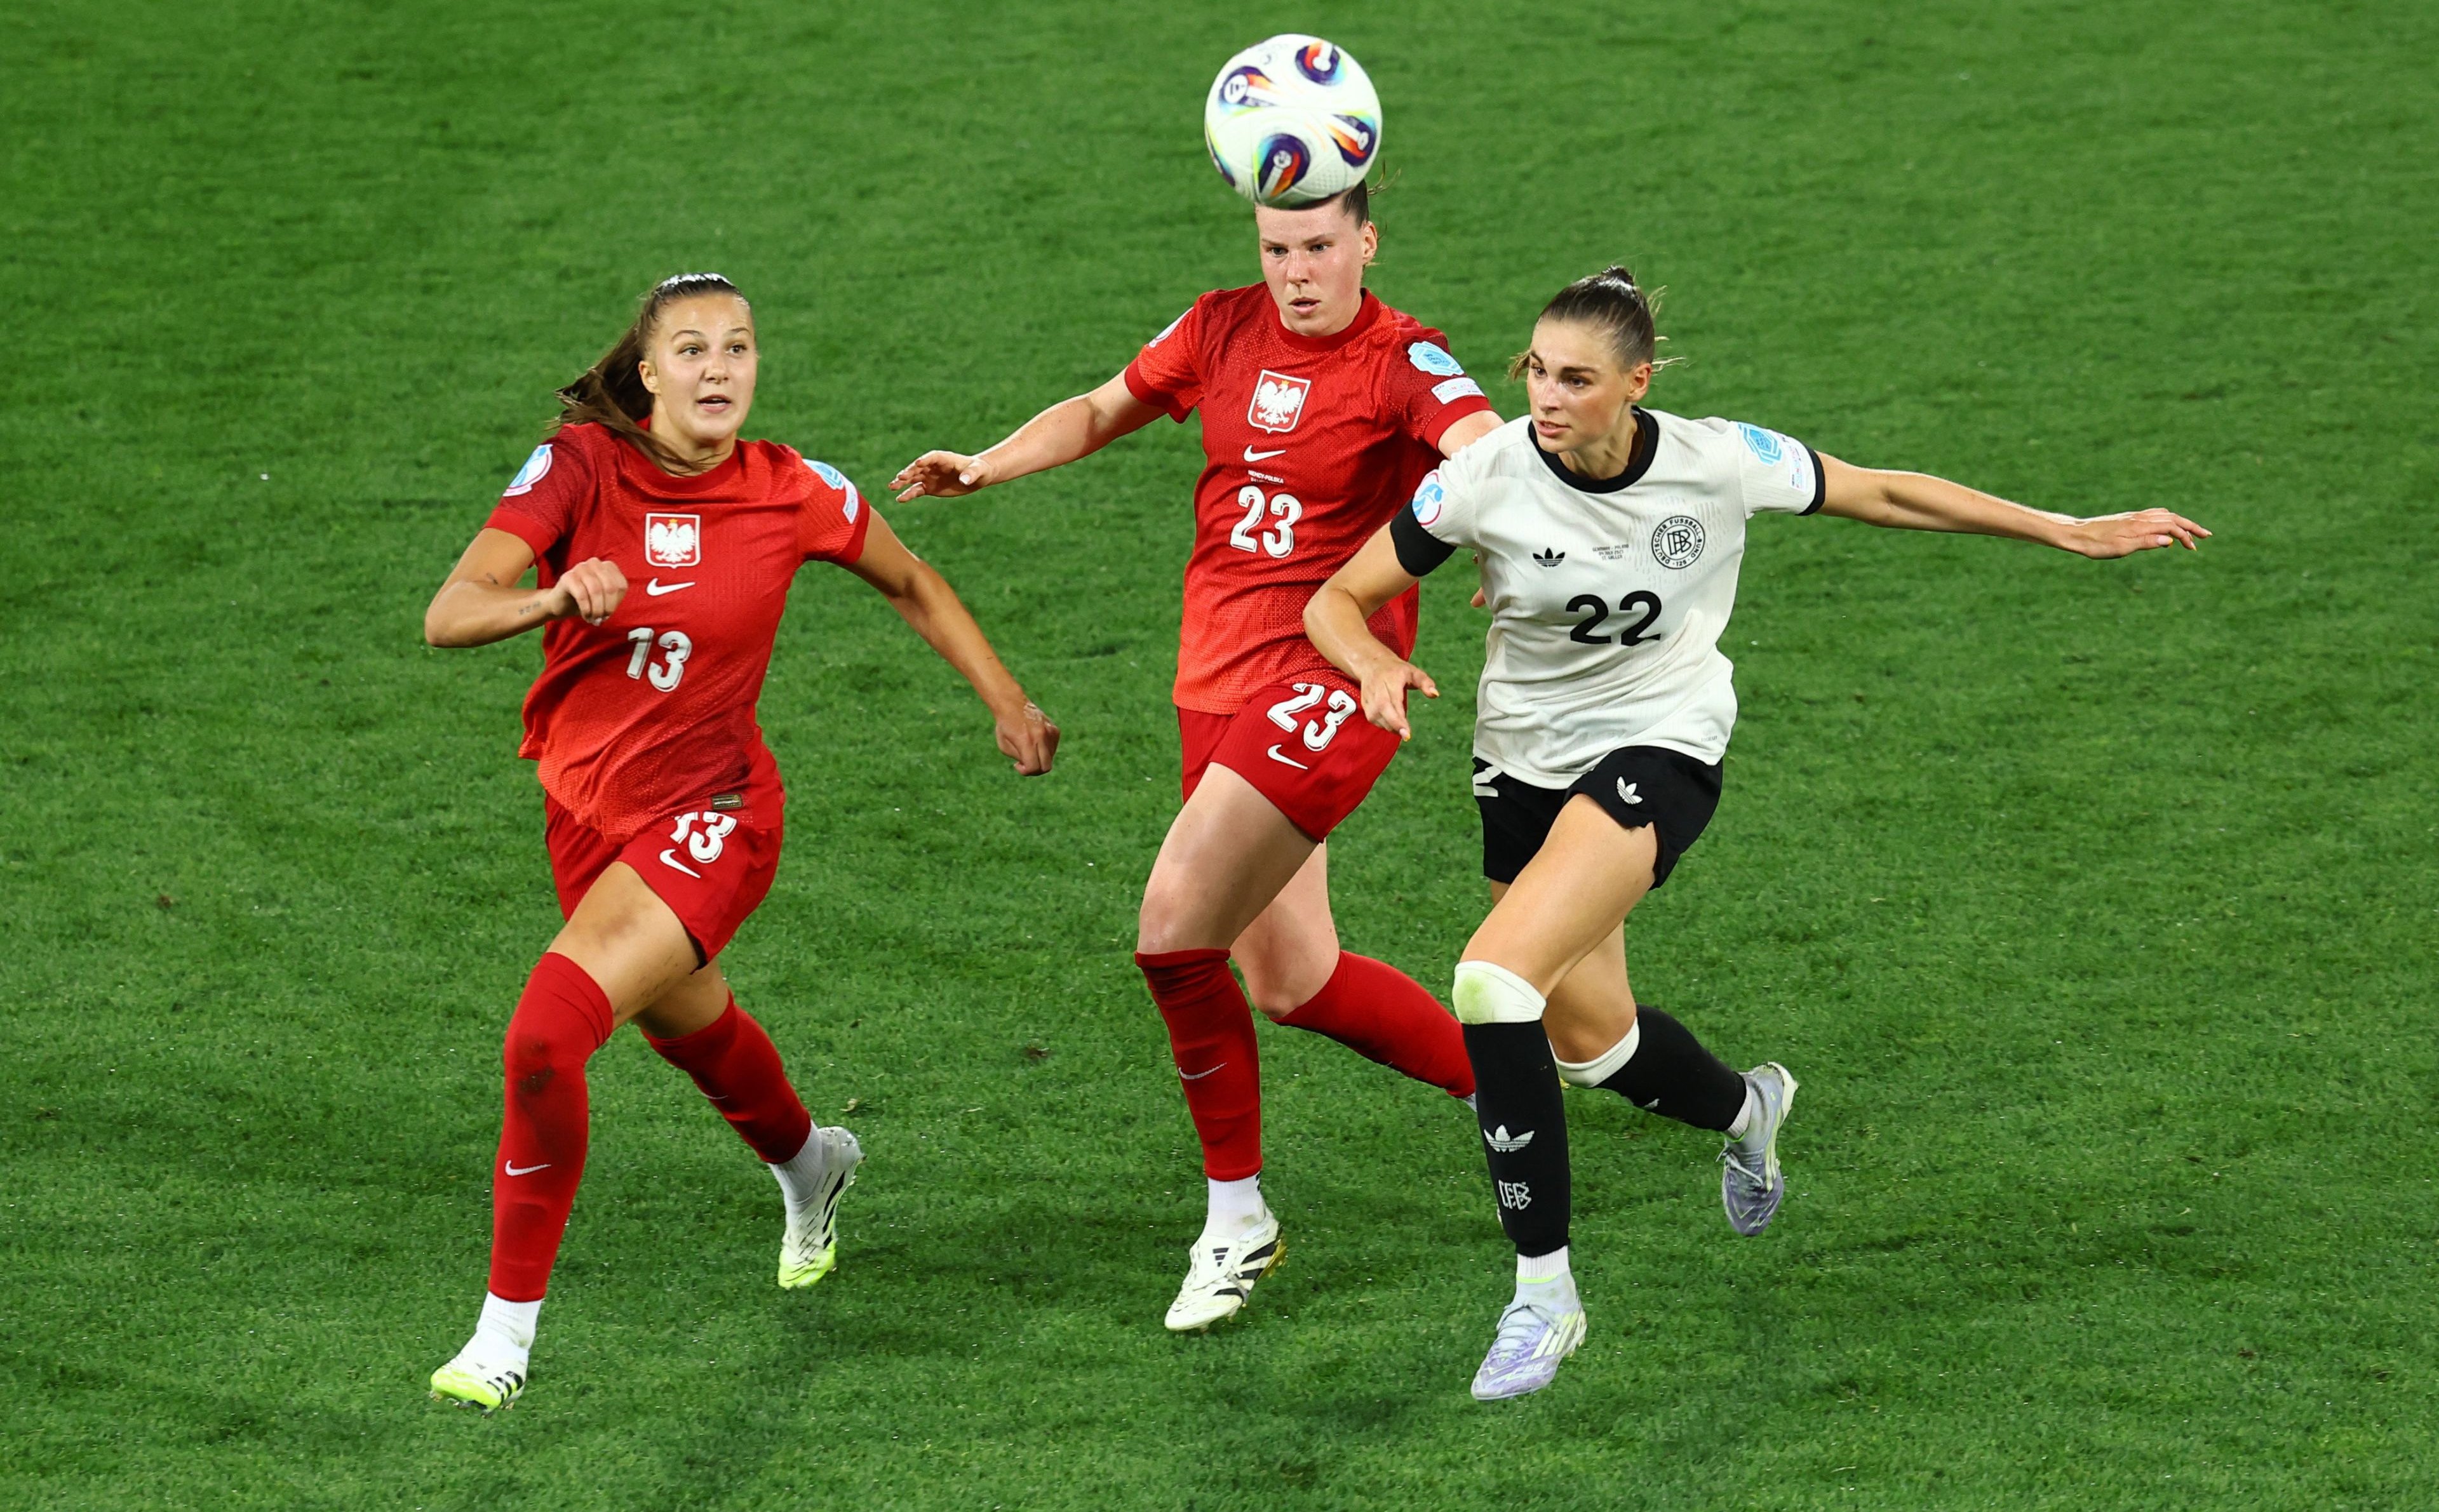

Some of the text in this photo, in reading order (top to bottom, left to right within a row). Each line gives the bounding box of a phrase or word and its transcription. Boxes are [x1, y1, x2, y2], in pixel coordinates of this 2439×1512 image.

[1229, 485, 1303, 559] 23
[1654, 524, 1670, 565] DEUTSCHER
[1564, 590, 1663, 647] 22
[626, 627, 693, 693] 13
[1267, 682, 1357, 752] 23
[669, 810, 737, 864] 13
